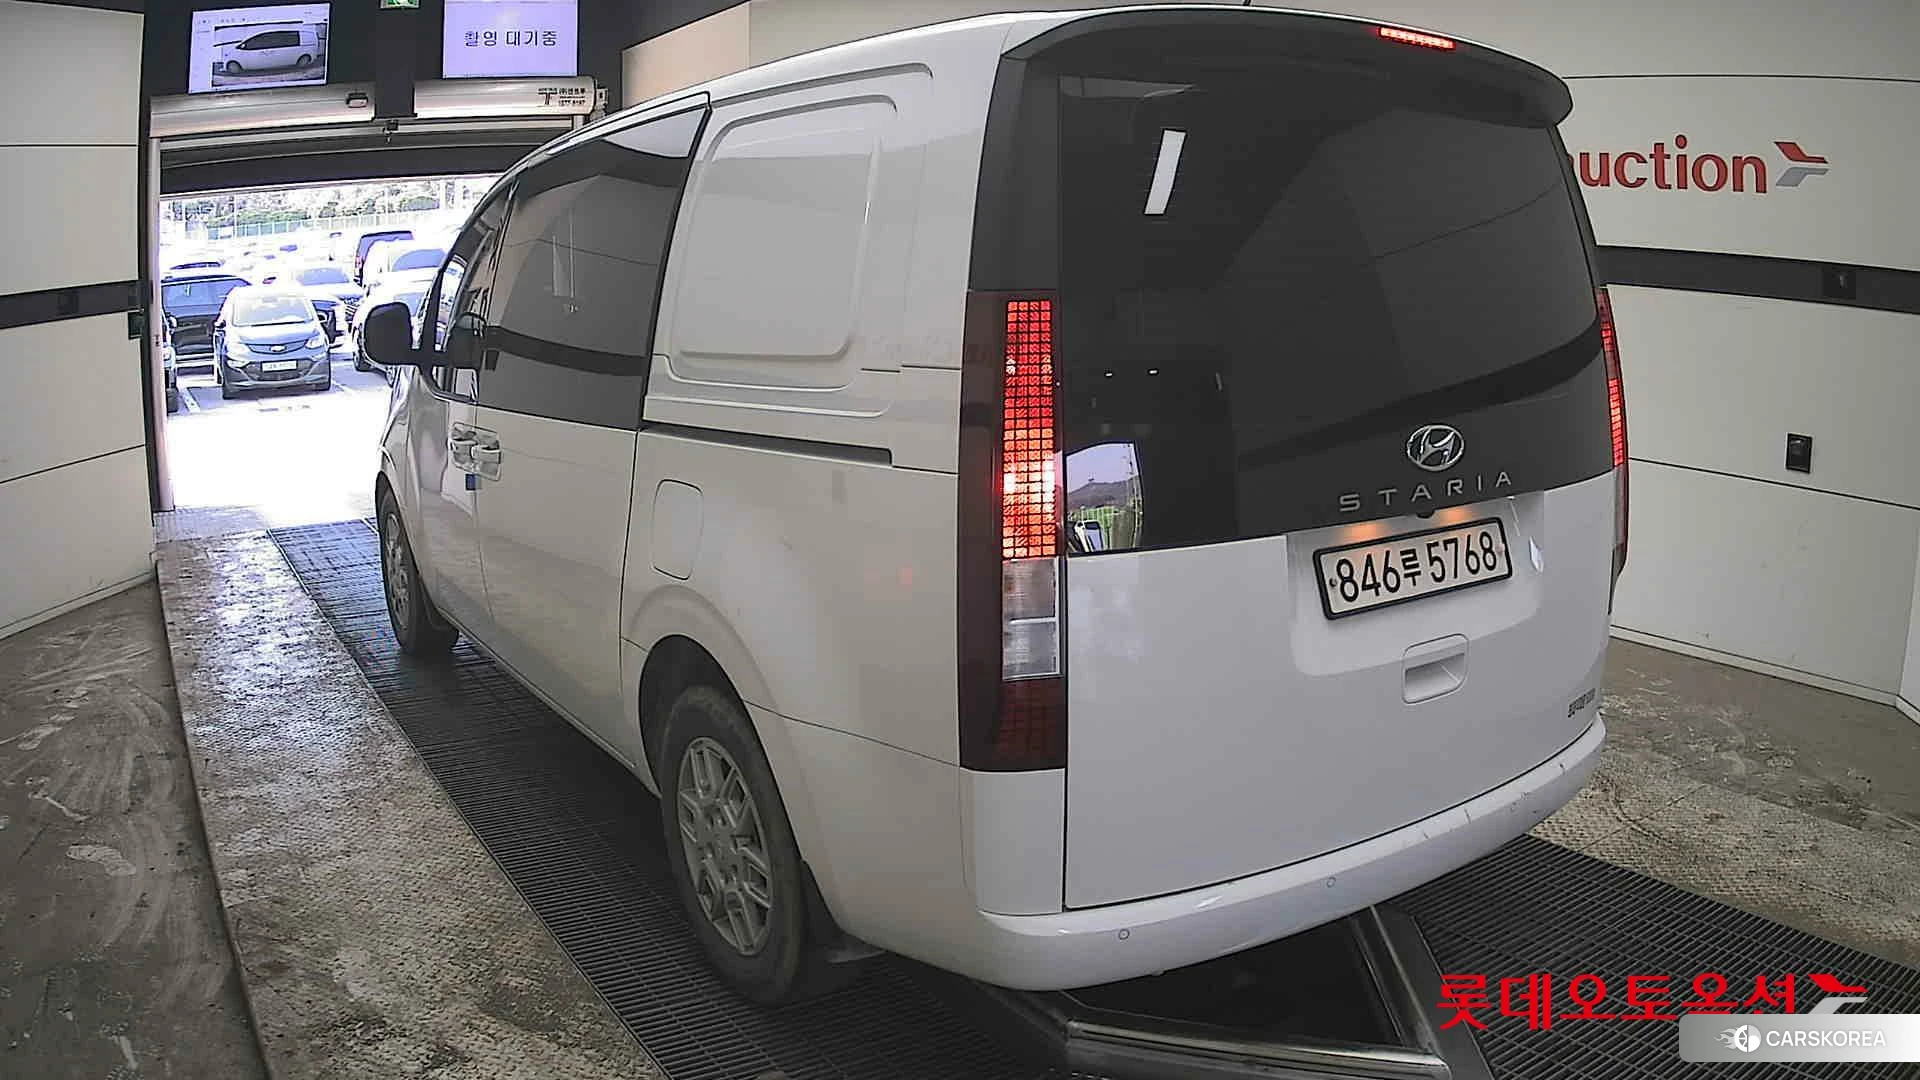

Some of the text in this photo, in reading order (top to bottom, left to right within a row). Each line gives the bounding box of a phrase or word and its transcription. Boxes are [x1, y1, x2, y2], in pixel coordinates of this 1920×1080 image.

[506, 31, 557, 47] 대기중
[1568, 134, 1767, 193] uction
[1339, 471, 1512, 512] STARIA
